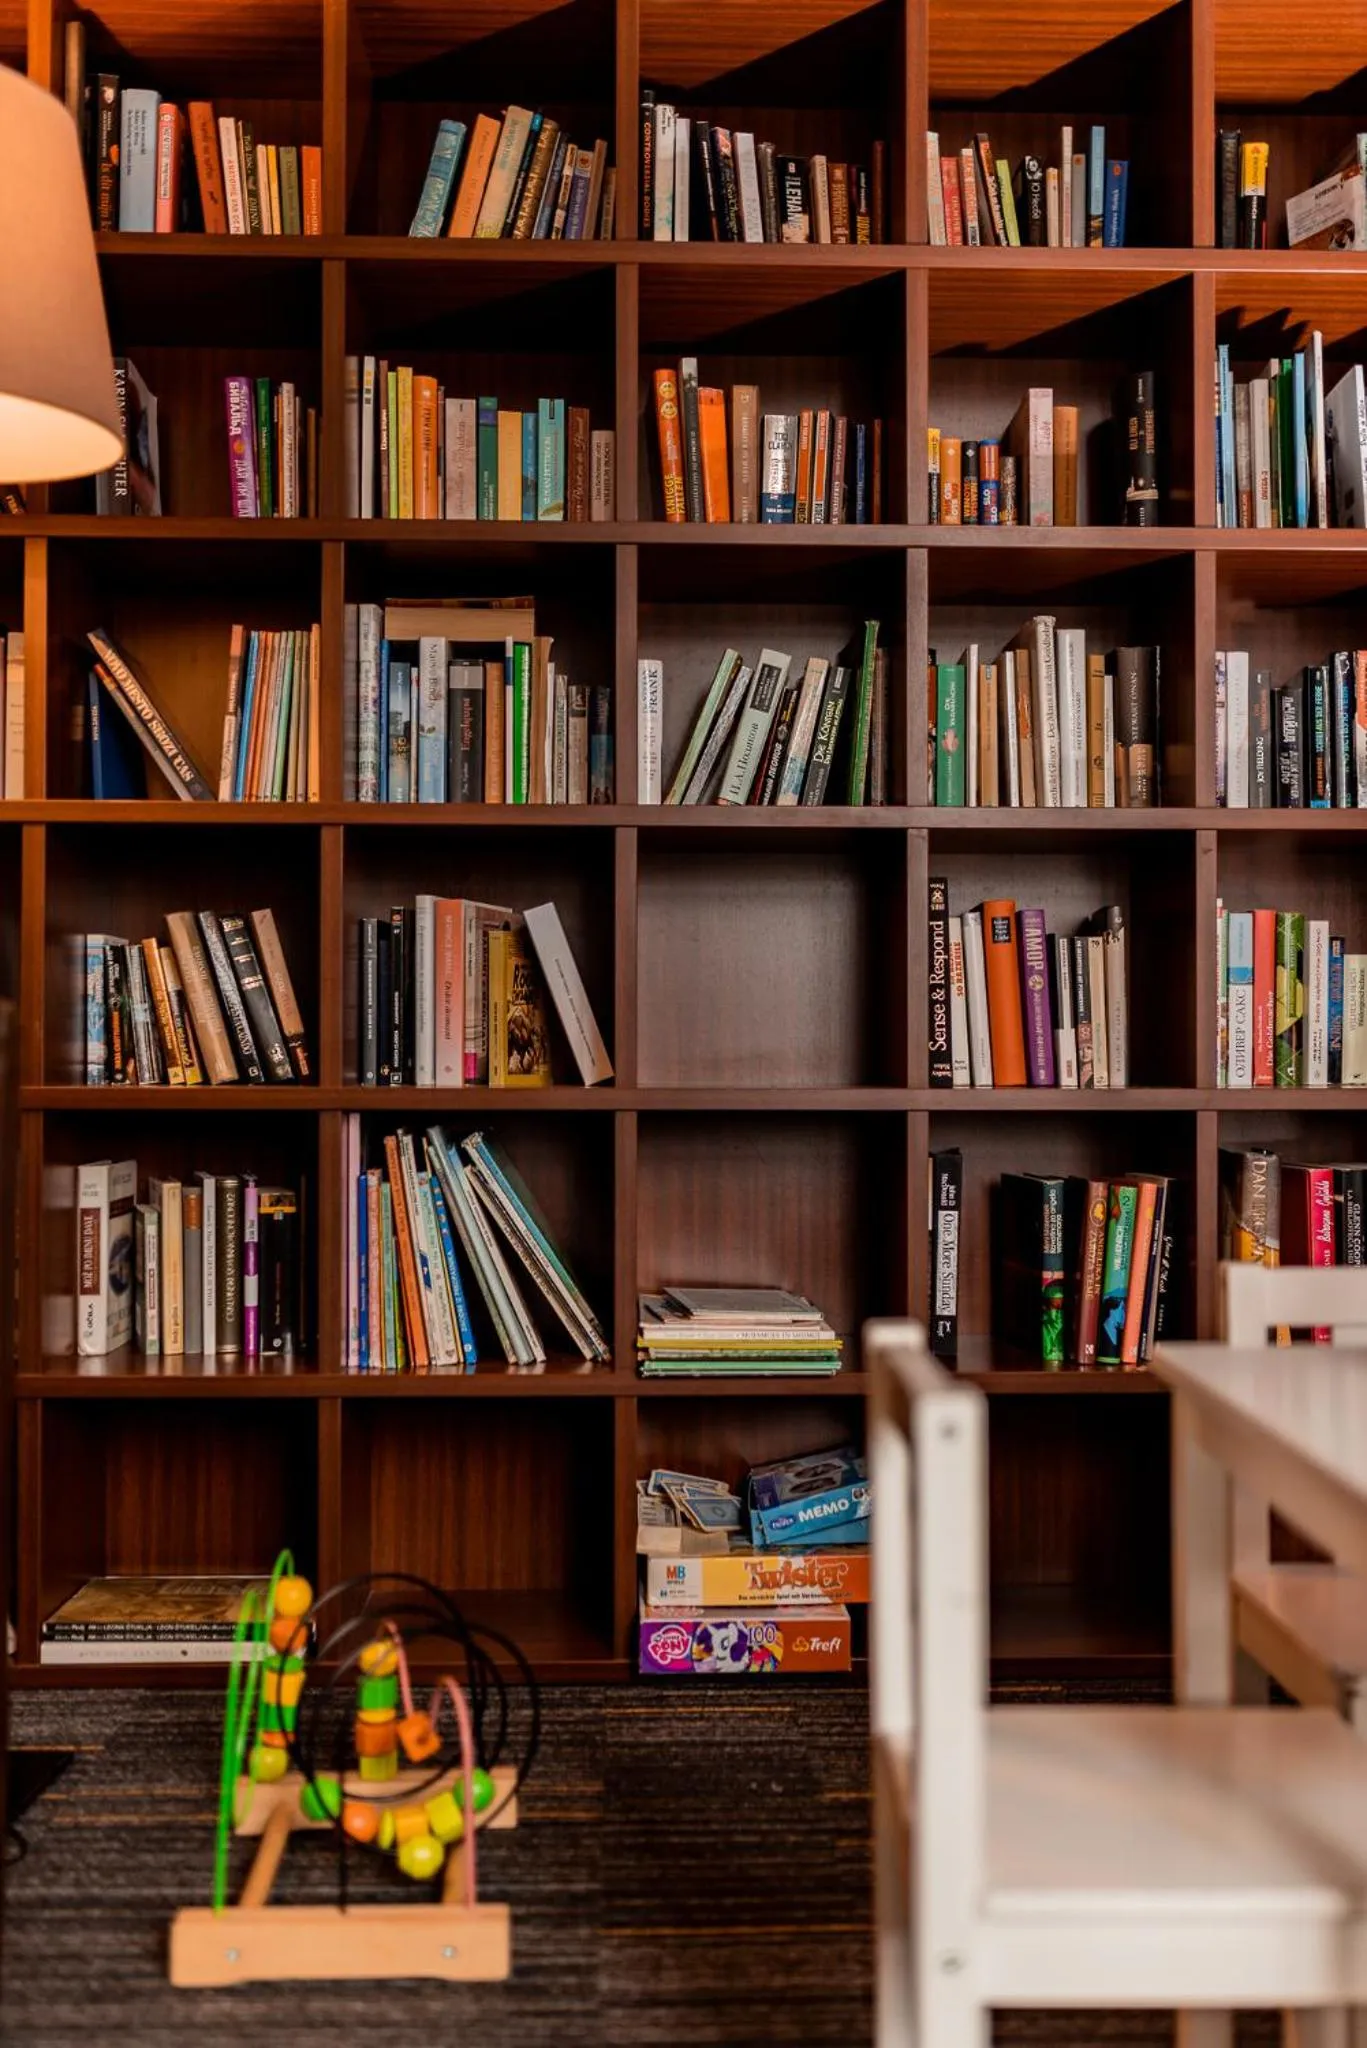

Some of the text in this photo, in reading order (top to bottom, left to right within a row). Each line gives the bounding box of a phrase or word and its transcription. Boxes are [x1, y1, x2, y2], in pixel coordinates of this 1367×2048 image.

[649, 669, 658, 714] FRANK
[929, 920, 946, 1051] Sense & Respond
[1235, 989, 1246, 1078] ОЛИВЕР САКС
[1252, 1161, 1267, 1198] DAN
[941, 1213, 954, 1312] One More Sunday
[798, 1498, 849, 1522] MEMO
[666, 1565, 686, 1579] MB
[743, 1559, 849, 1590] Twister
[809, 1636, 841, 1653] Trefl
